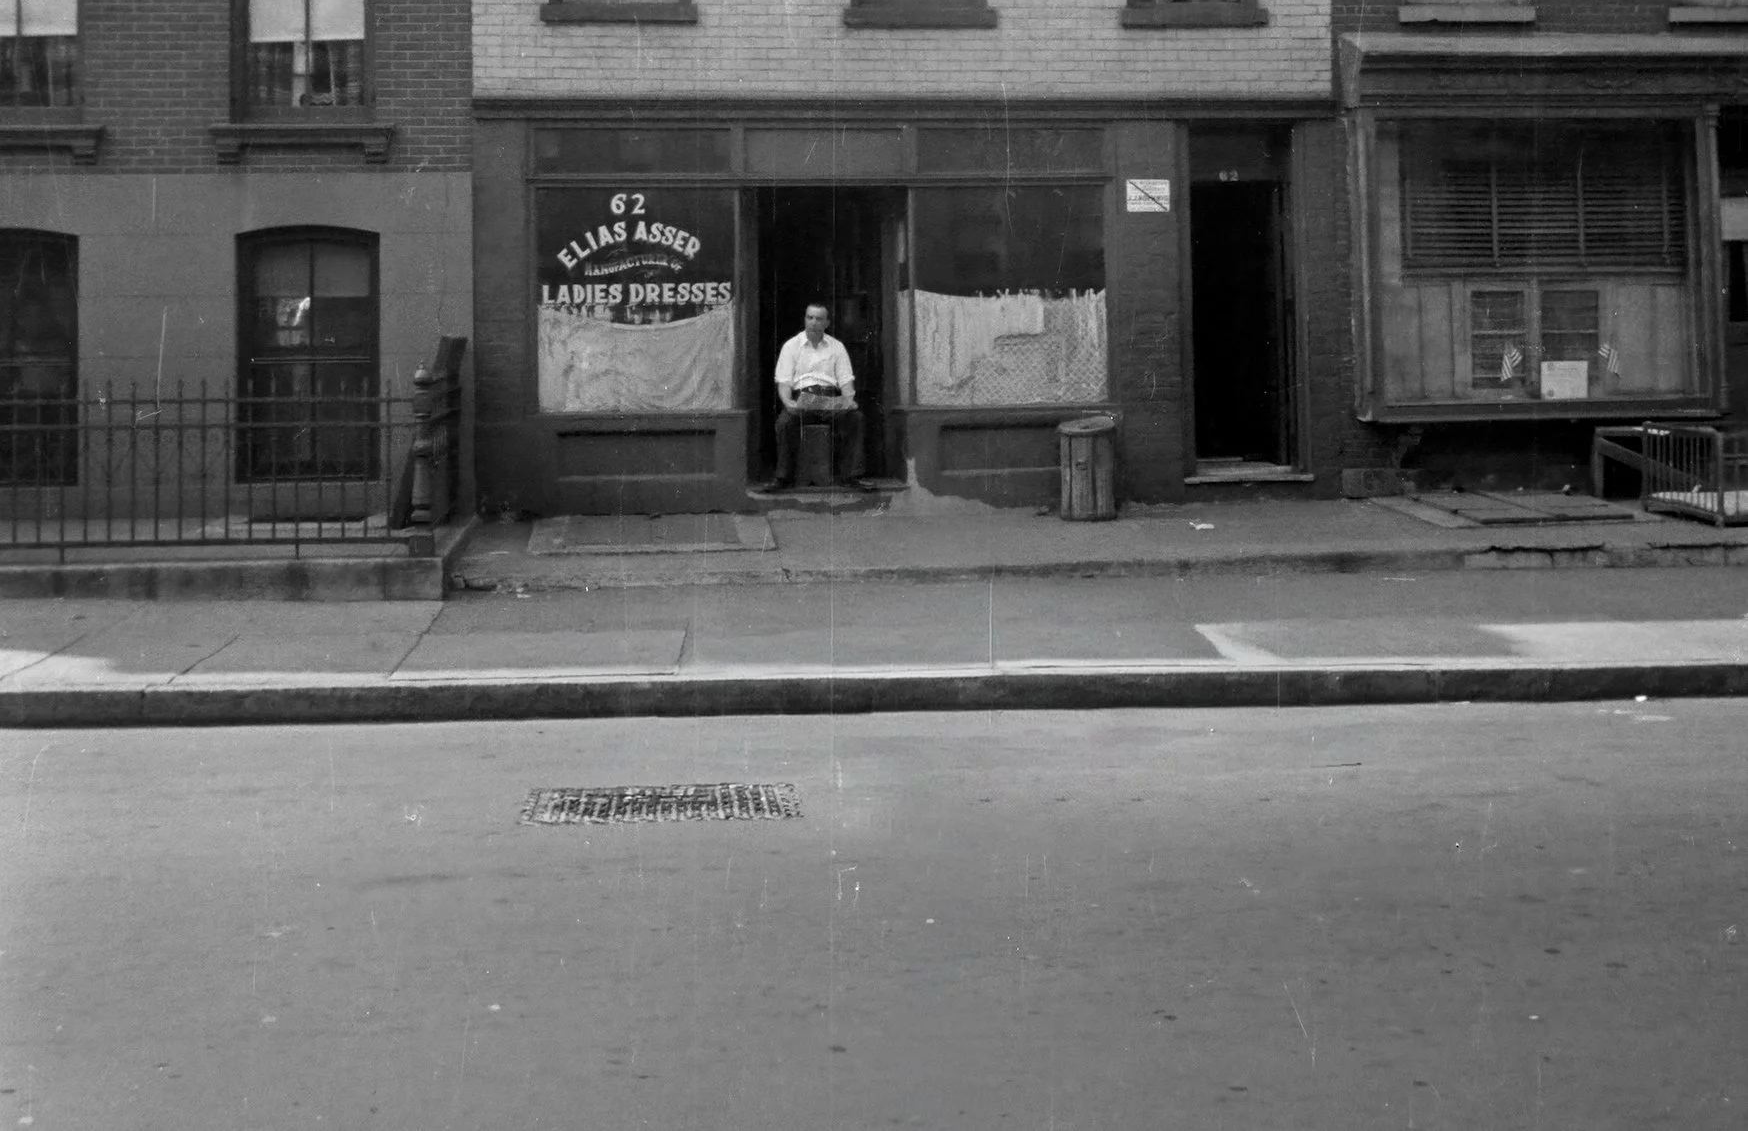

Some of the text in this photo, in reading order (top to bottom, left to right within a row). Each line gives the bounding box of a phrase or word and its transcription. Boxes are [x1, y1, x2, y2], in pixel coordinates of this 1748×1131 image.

[610, 192, 645, 215] 62
[556, 220, 701, 270] ELIAS ASSER
[542, 281, 732, 305] LADIES DRESSES
